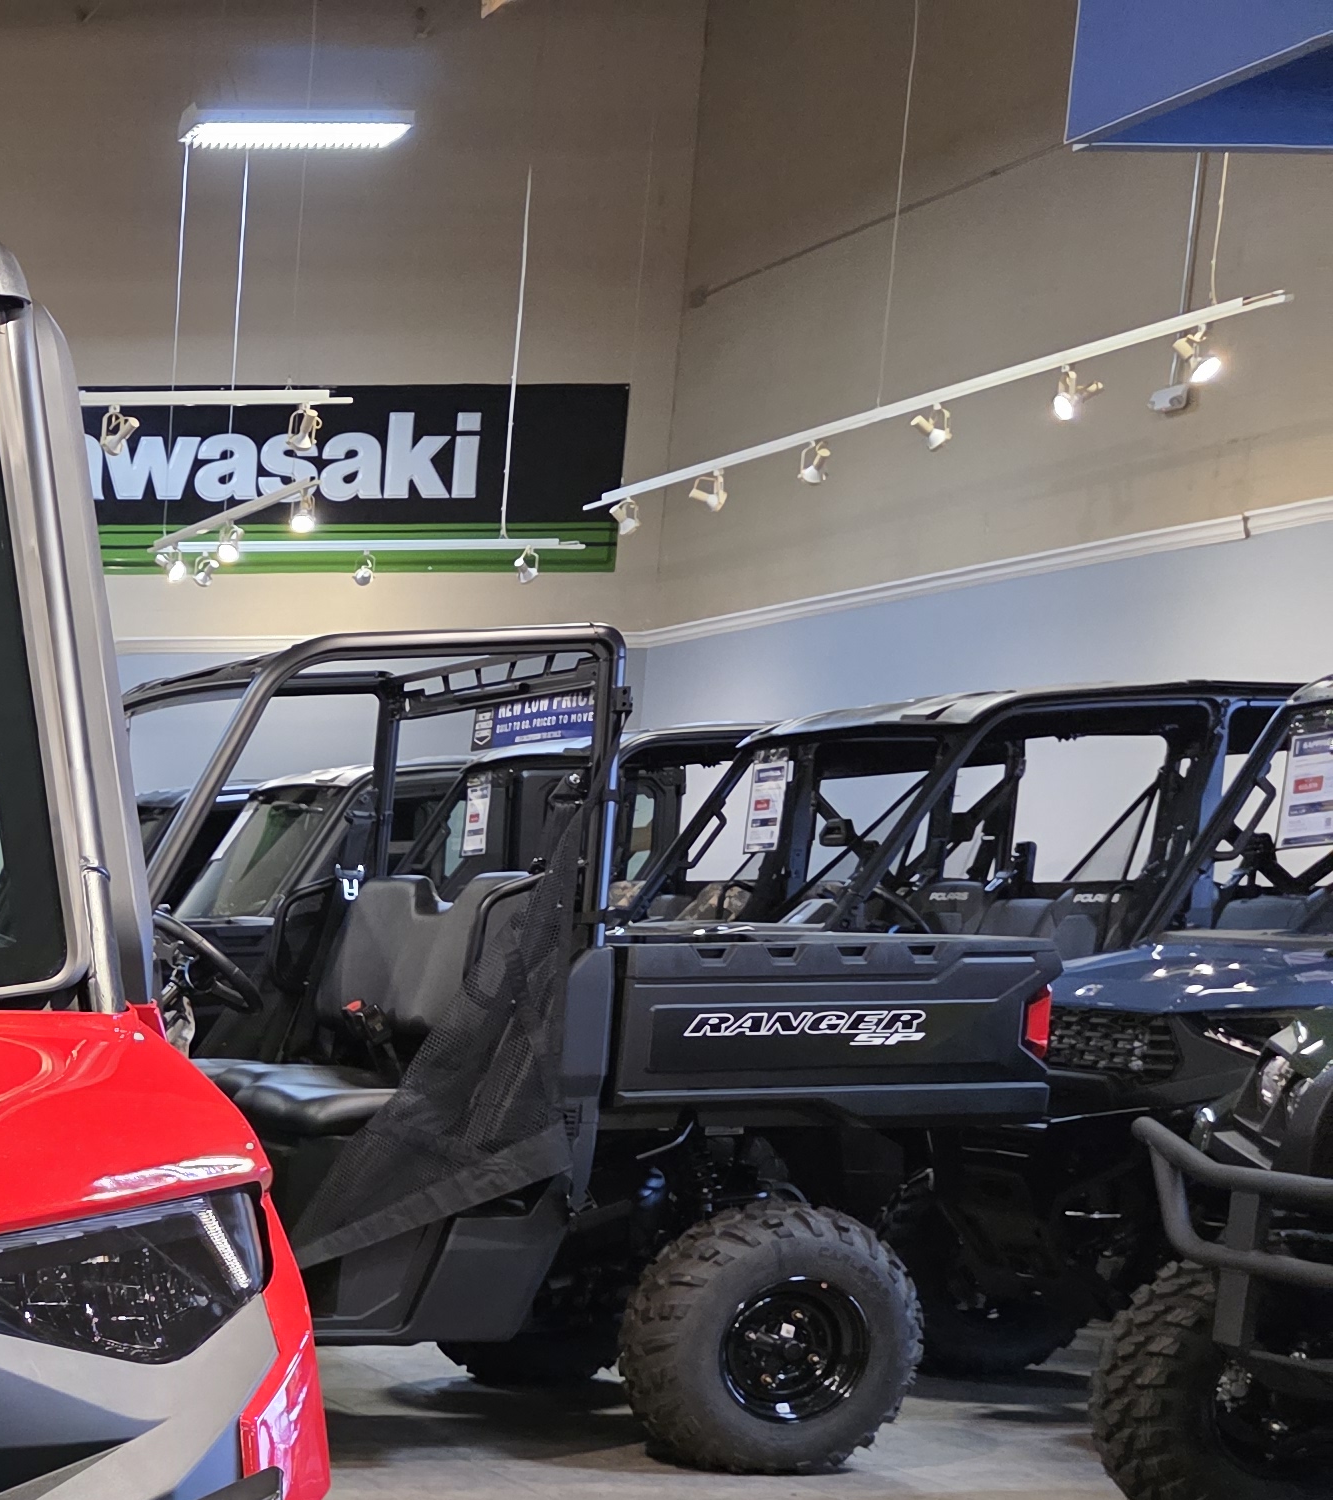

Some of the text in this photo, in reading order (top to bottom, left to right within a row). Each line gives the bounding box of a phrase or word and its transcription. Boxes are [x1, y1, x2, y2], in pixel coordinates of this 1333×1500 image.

[532, 715, 556, 728] PRICED
[558, 714, 568, 724] TO
[570, 711, 594, 723] MOVE
[683, 1009, 926, 1037] RANGER
[849, 1032, 925, 1046] SP
